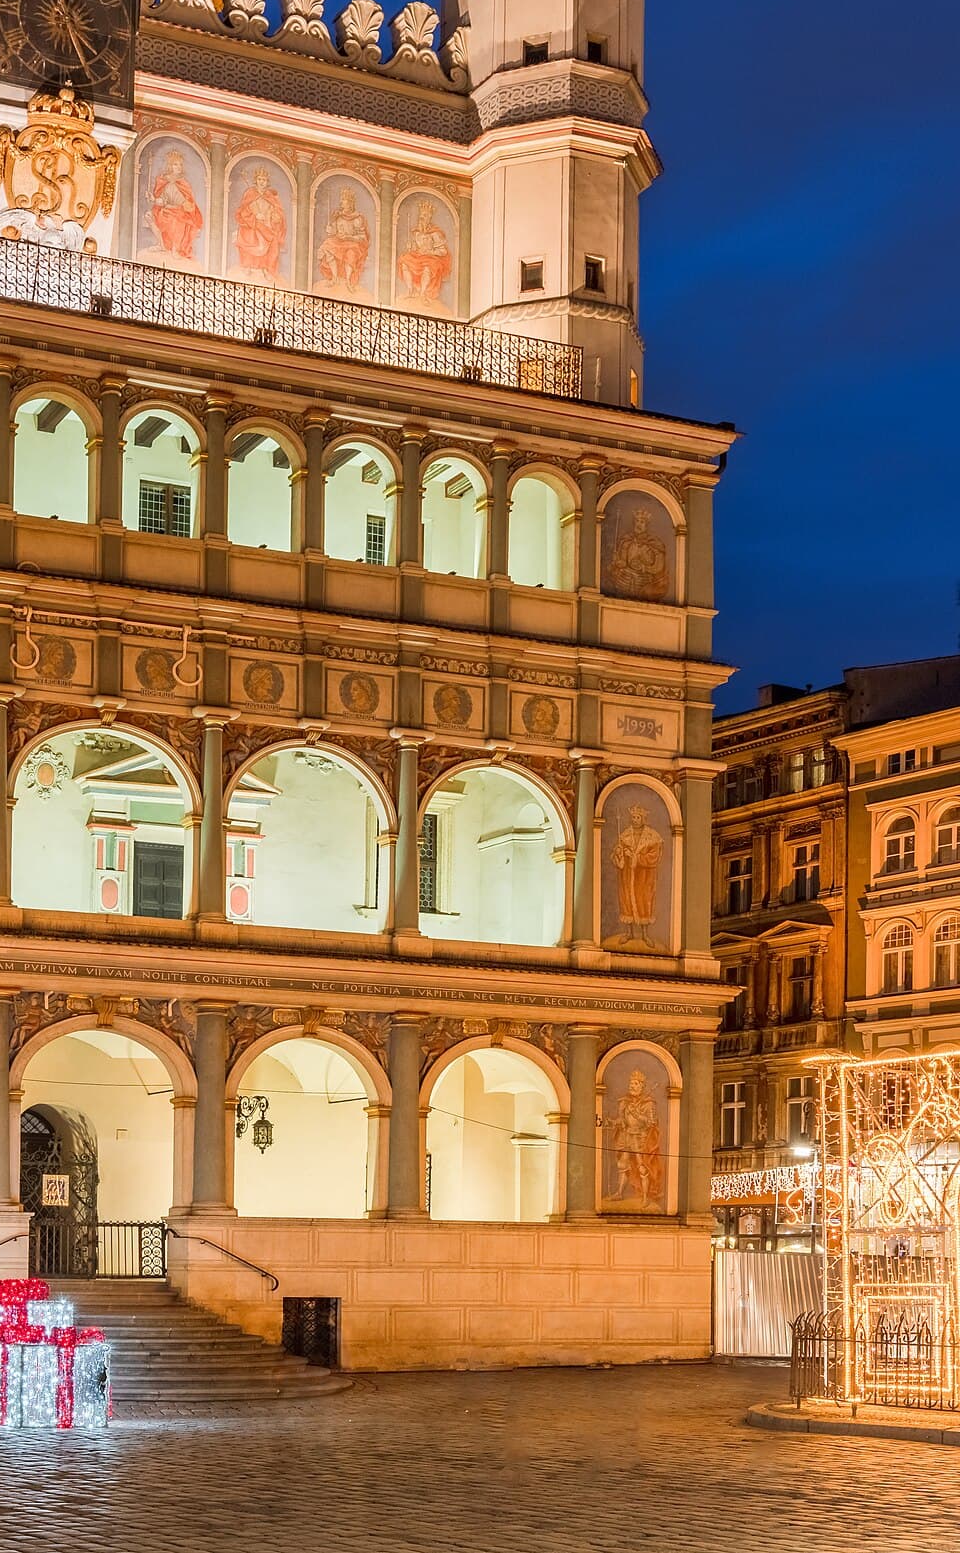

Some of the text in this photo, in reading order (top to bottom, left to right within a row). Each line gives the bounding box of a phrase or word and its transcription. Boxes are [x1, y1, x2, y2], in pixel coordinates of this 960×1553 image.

[626, 717, 654, 735] 1999
[24, 964, 78, 975] PVPILVM
[142, 971, 187, 982] NOLITE
[194, 974, 271, 987] CONTRISTARE
[311, 982, 336, 991] NEC
[343, 984, 401, 995] POTENTIA
[411, 988, 465, 999] TVRPITER
[473, 992, 496, 1001] NEC
[504, 994, 537, 1004] METV
[544, 997, 587, 1007] RECTVM
